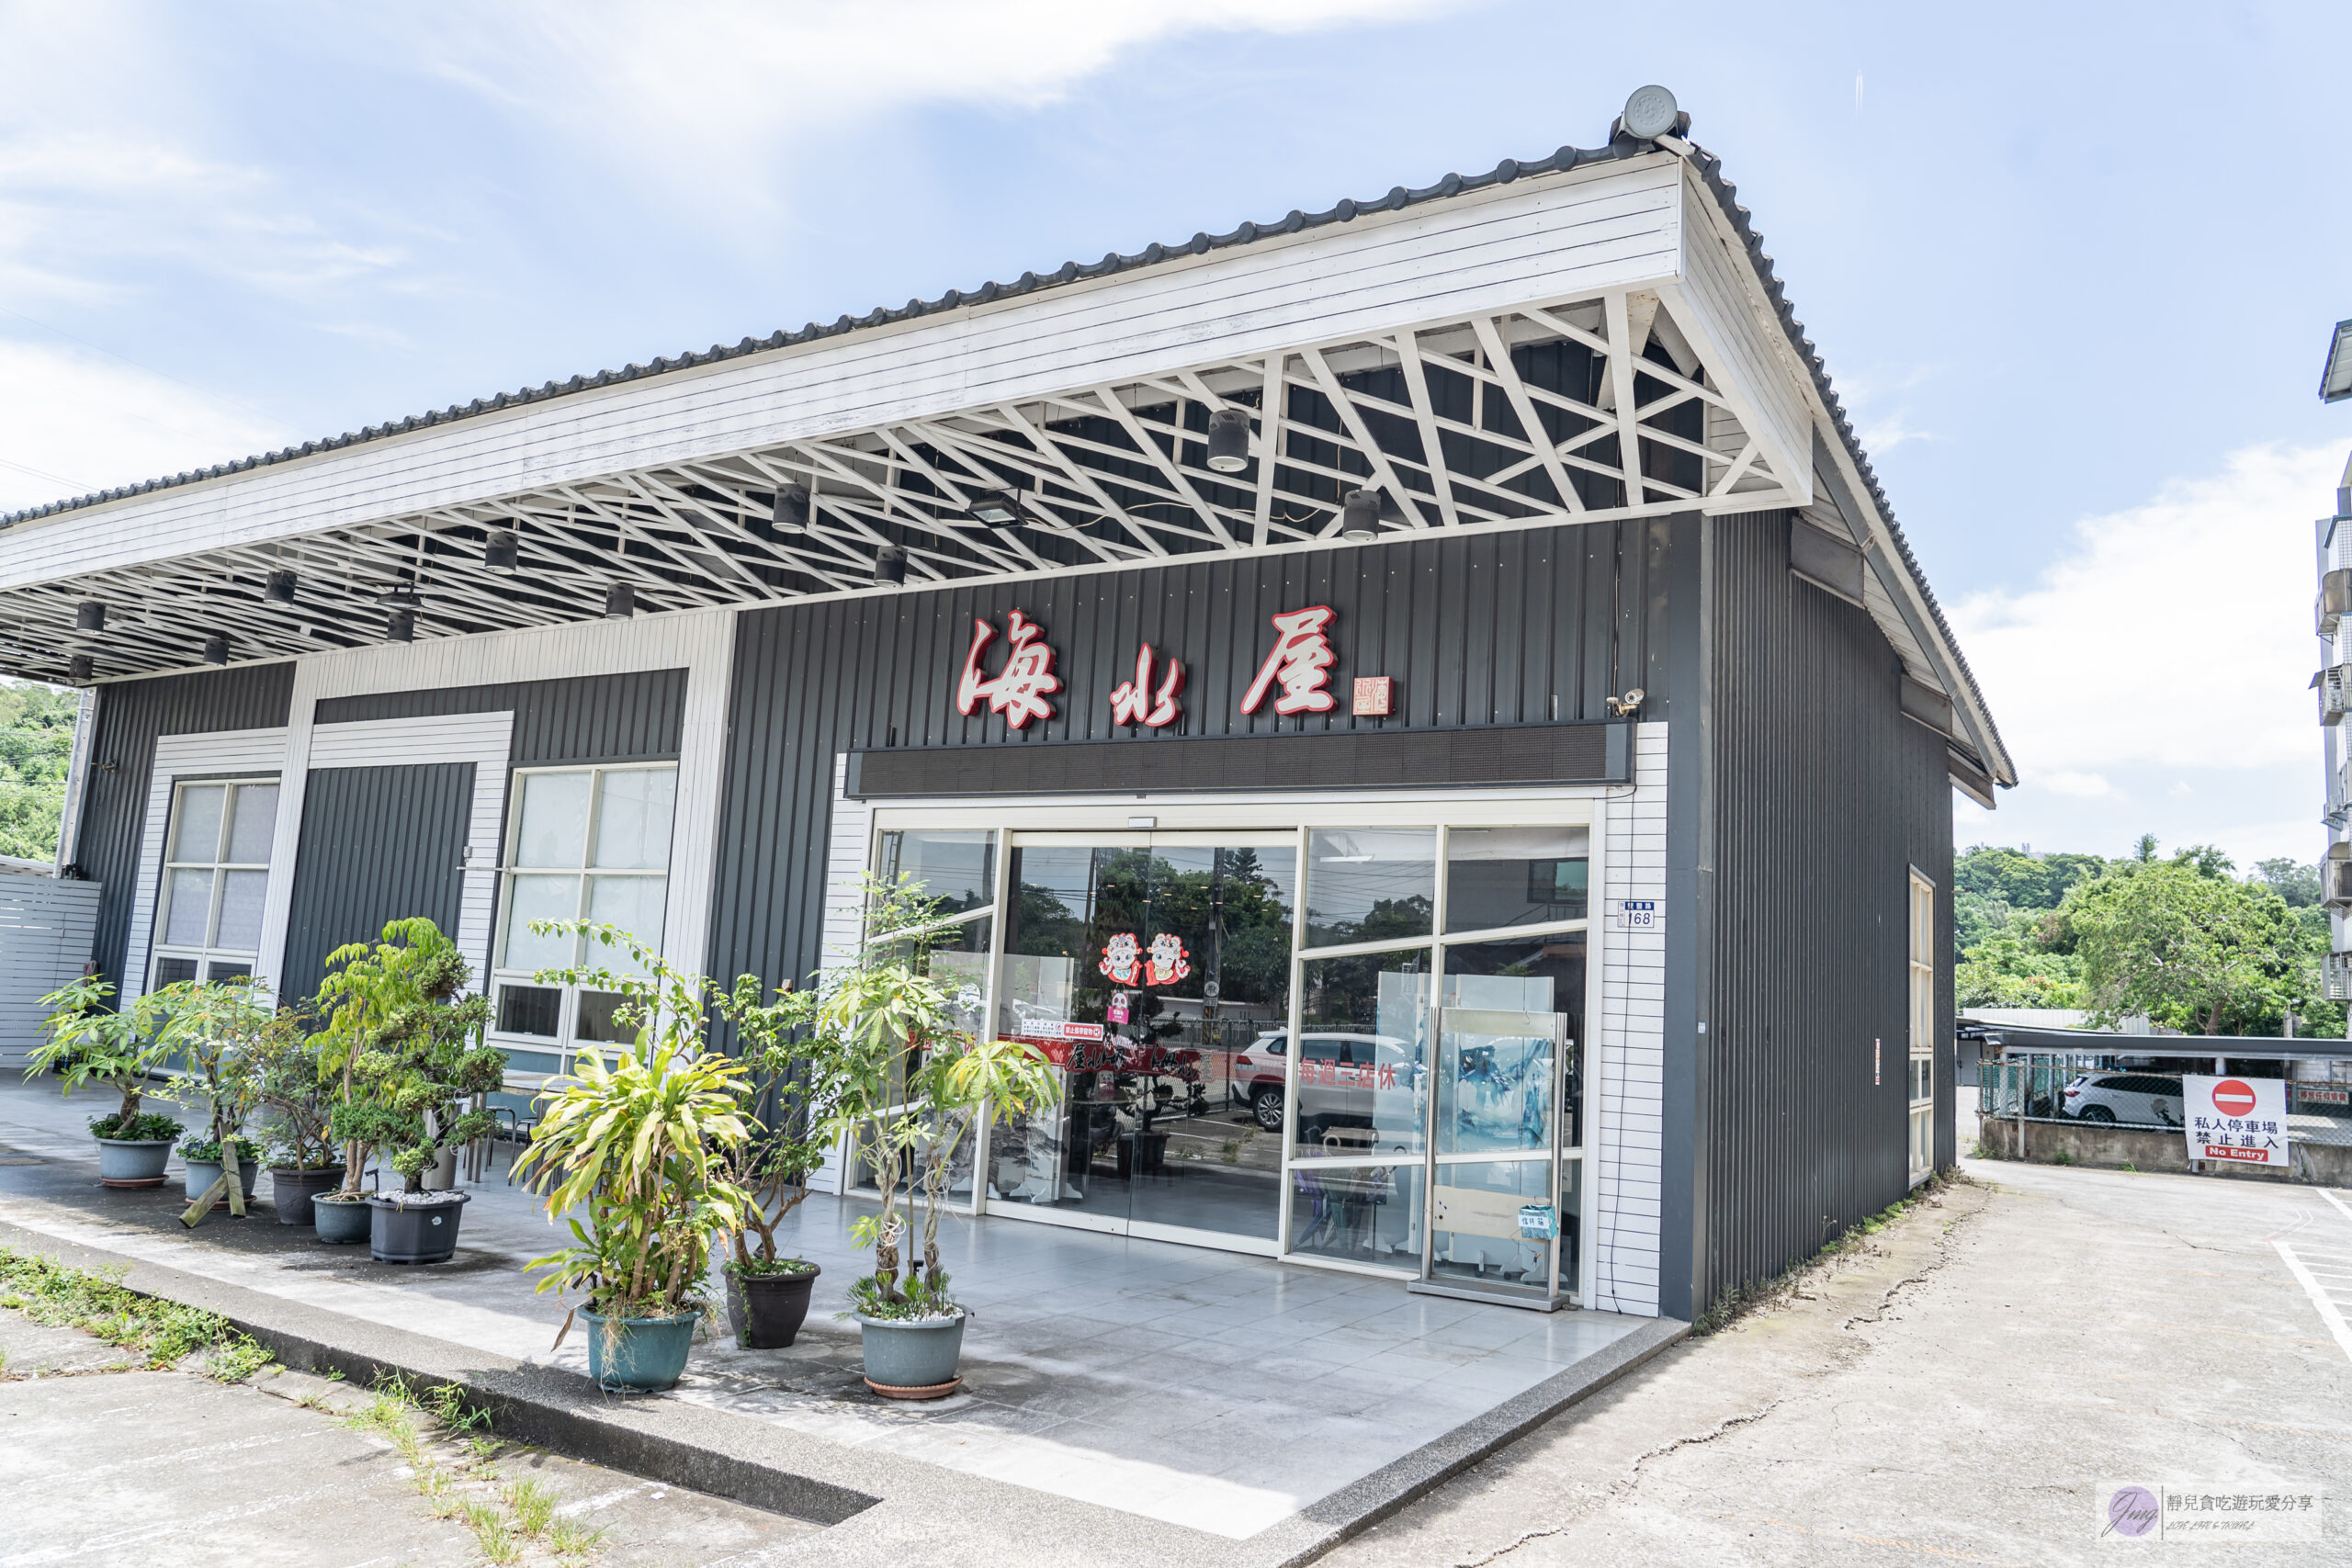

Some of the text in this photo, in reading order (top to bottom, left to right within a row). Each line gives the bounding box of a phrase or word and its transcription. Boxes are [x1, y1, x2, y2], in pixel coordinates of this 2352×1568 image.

[957, 604, 1339, 730] 海水屋
[1628, 912, 1651, 925] 168
[1299, 1056, 1396, 1090] 每週三店休
[2194, 1117, 2278, 1134] 私人停車場
[2196, 1131, 2278, 1149] 禁止進入
[2209, 1147, 2265, 1161] No Entry
